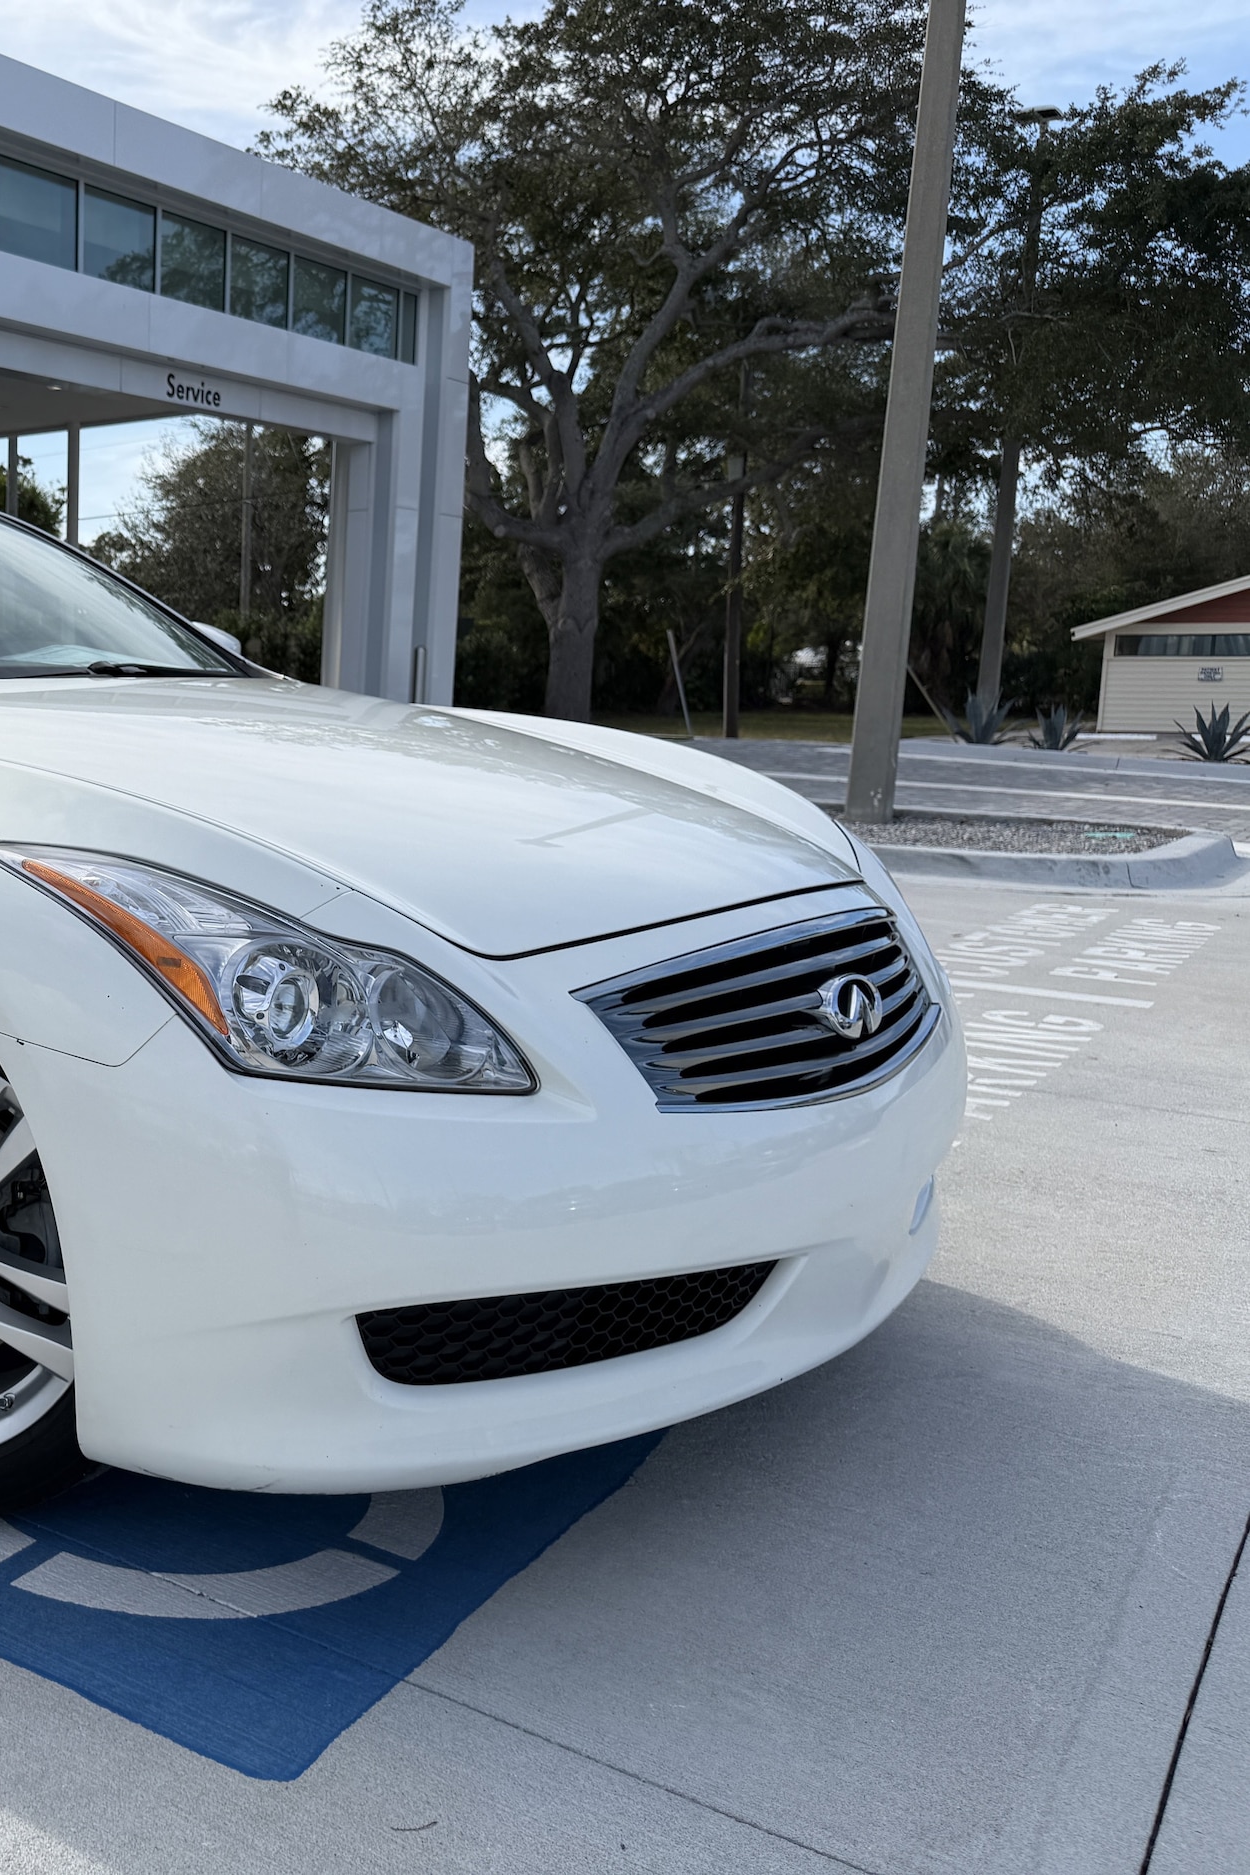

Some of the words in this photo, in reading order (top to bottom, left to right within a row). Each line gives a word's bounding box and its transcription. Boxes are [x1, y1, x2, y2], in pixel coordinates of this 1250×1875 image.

[166, 373, 221, 407] Service
[1049, 918, 1221, 986] PARKING
[953, 1010, 1104, 1146] KING
